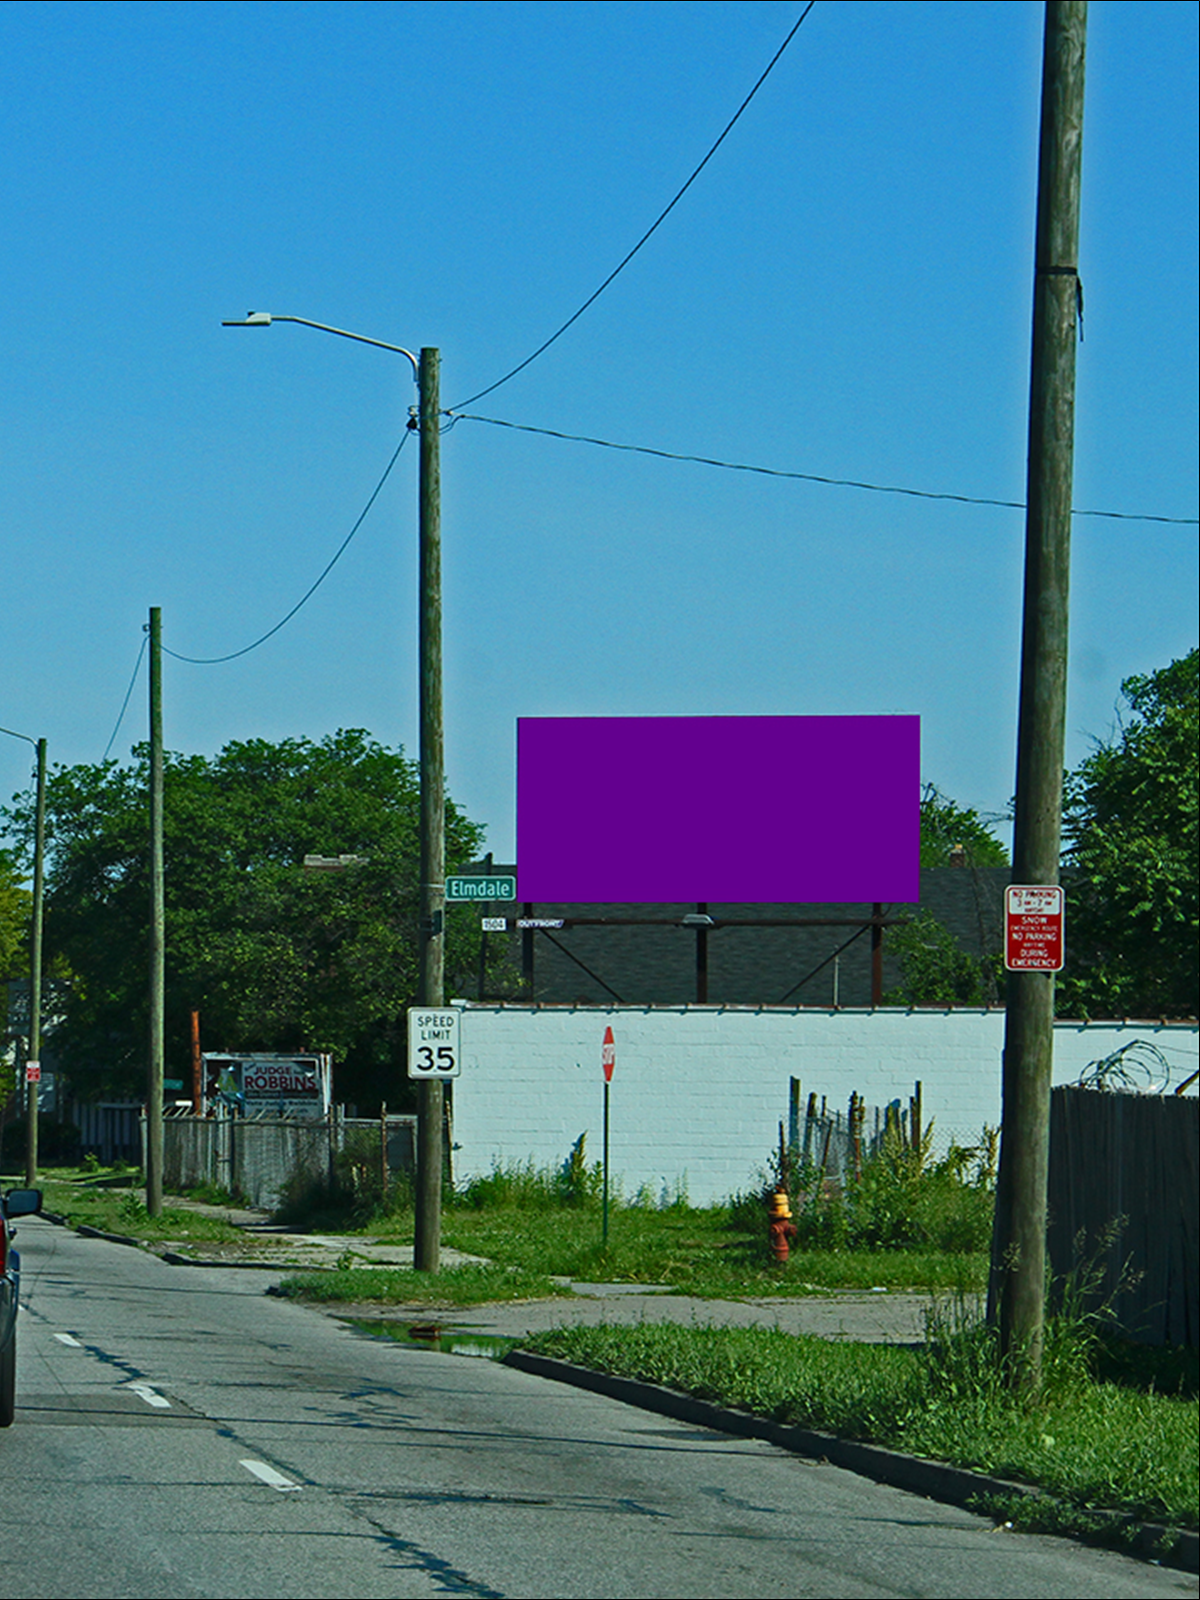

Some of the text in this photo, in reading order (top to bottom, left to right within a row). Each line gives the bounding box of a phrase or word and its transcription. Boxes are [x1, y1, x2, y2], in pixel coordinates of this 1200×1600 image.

[451, 880, 510, 897] Elmdale
[1012, 890, 1057, 900] NO PARKING
[518, 919, 563, 929] OUTFRONT
[1021, 915, 1048, 925] SNOW
[1012, 932, 1057, 942] NO PARKING
[1020, 949, 1049, 958] DURING
[1011, 958, 1057, 967] EMERGENCY
[417, 1015, 455, 1027] SPEED
[421, 1030, 451, 1040] LIMIT
[416, 1046, 455, 1071] 35
[254, 1066, 292, 1075] JUDGE
[244, 1075, 317, 1090] ROBBINS
